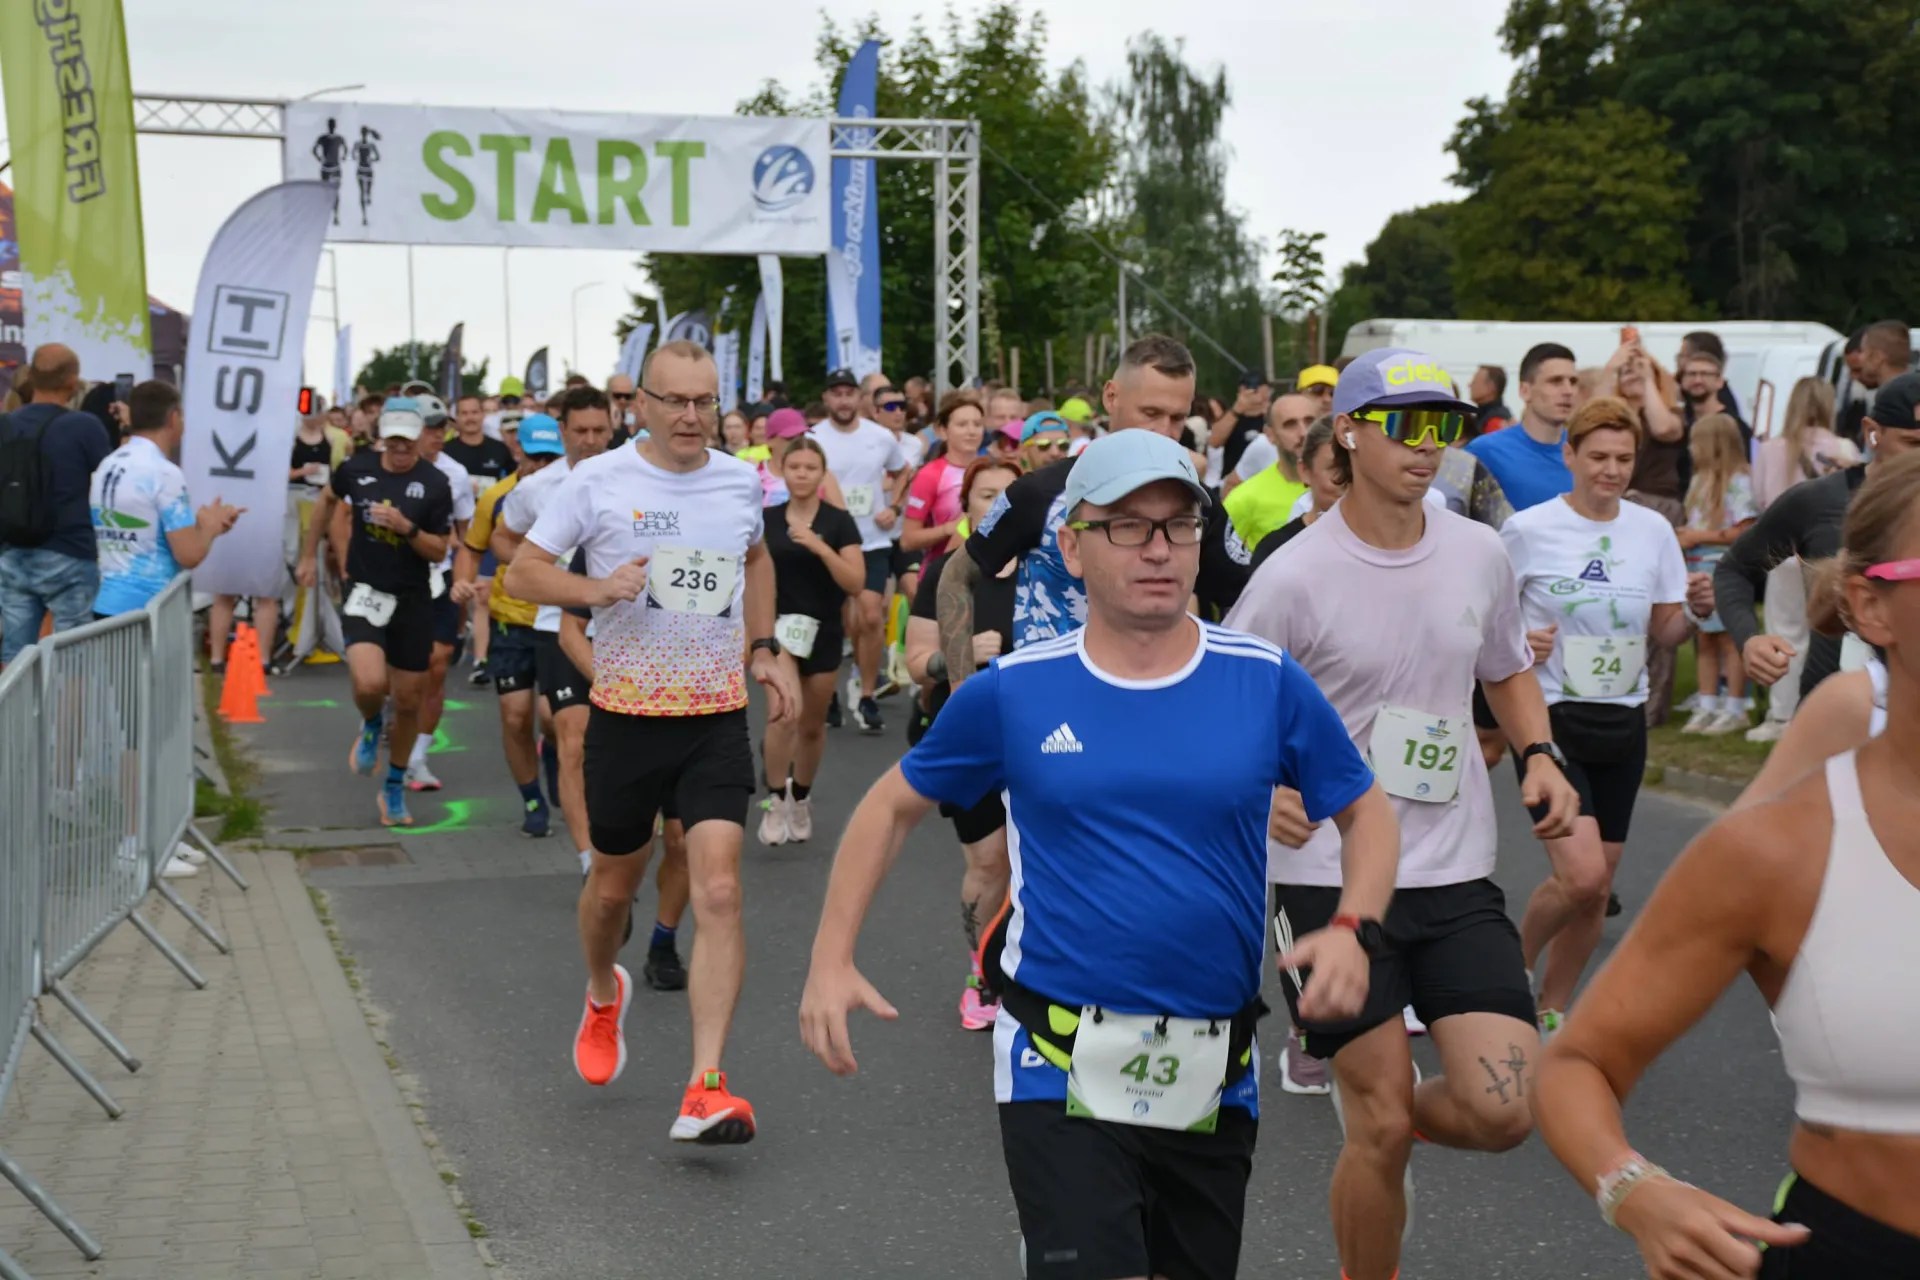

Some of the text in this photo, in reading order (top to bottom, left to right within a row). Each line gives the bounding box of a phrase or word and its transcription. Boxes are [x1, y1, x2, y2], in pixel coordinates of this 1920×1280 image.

[420, 129, 706, 227] START
[208, 293, 276, 480] KSH
[633, 520, 681, 530] DRUK
[644, 511, 680, 520] PAW
[670, 567, 718, 592] 236
[1591, 656, 1622, 676] 24
[1041, 740, 1083, 753] adidas
[1403, 738, 1458, 771] 192
[1120, 1052, 1180, 1087] 43
